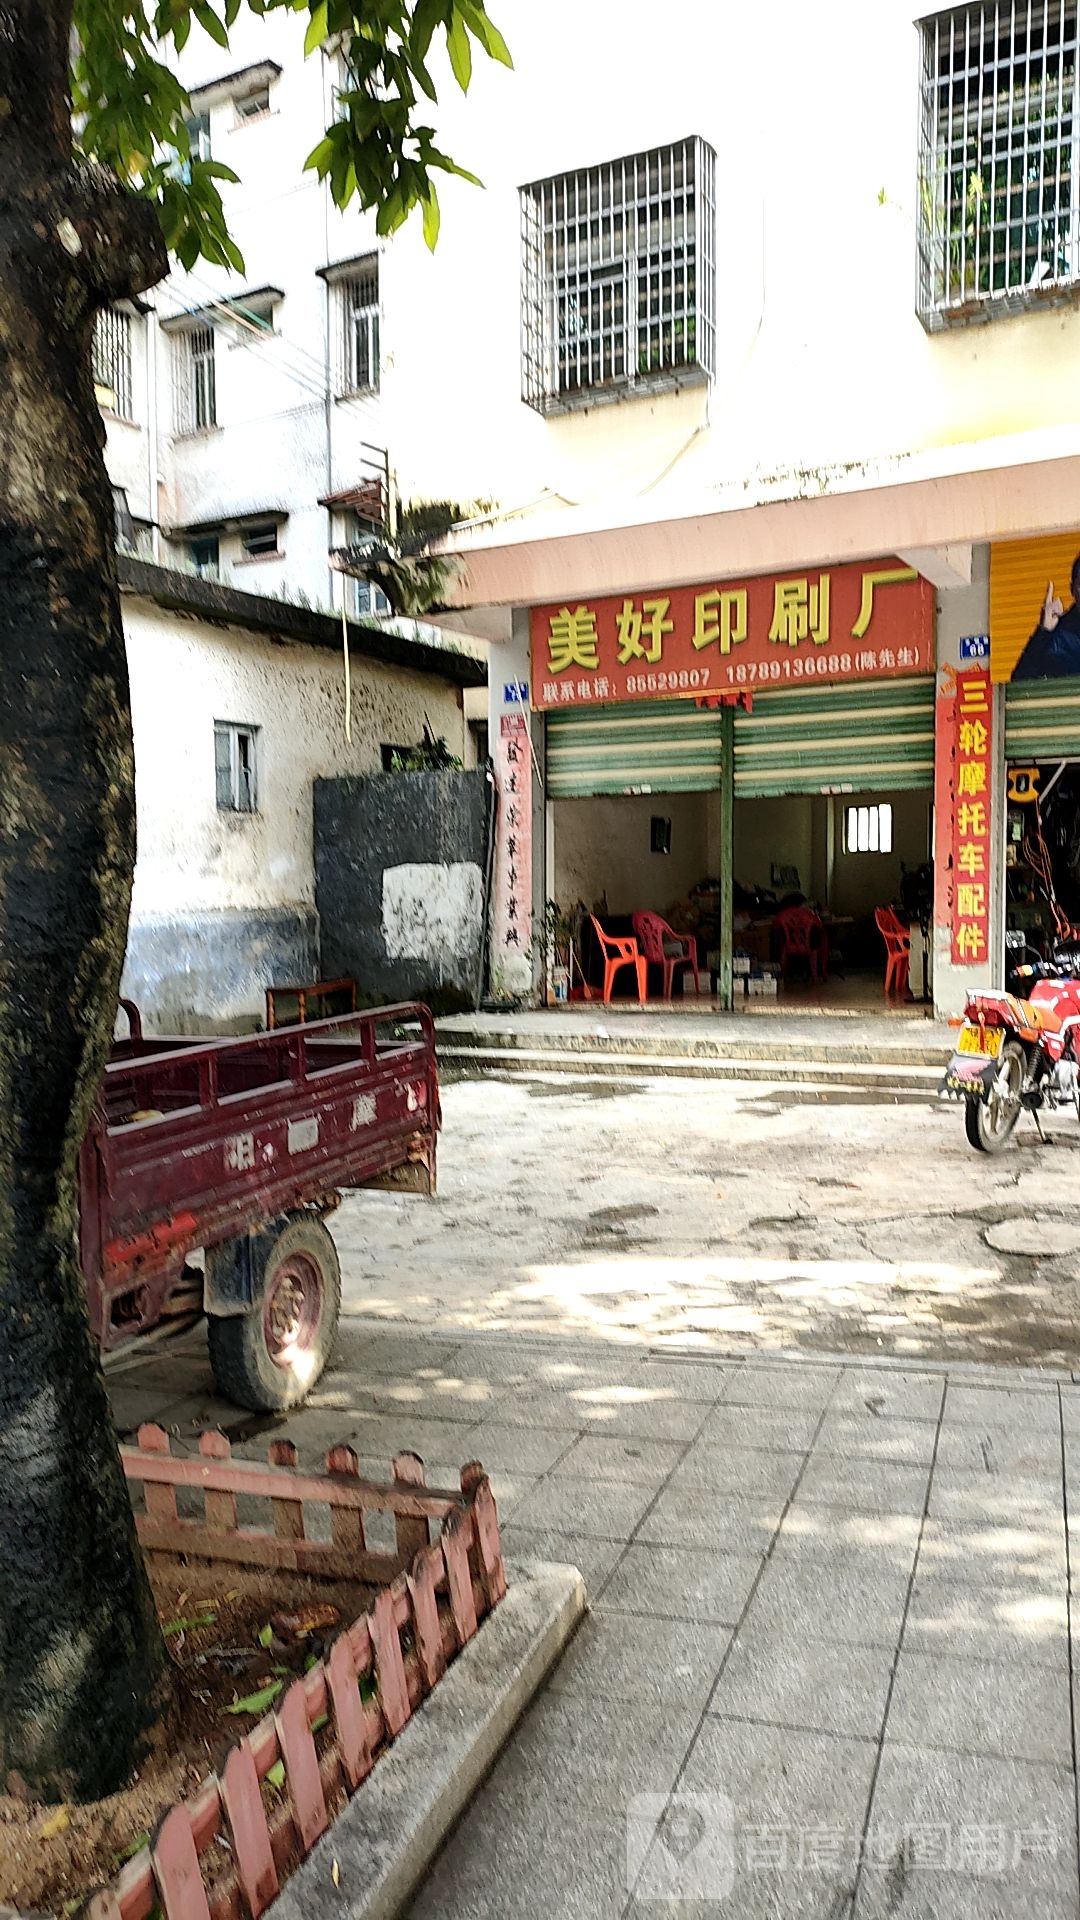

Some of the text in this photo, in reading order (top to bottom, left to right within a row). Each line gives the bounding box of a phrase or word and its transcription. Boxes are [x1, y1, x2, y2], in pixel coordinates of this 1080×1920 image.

[547, 569, 918, 674] 美好印刷厂
[956, 679, 988, 958] 三轮摩托车配件
